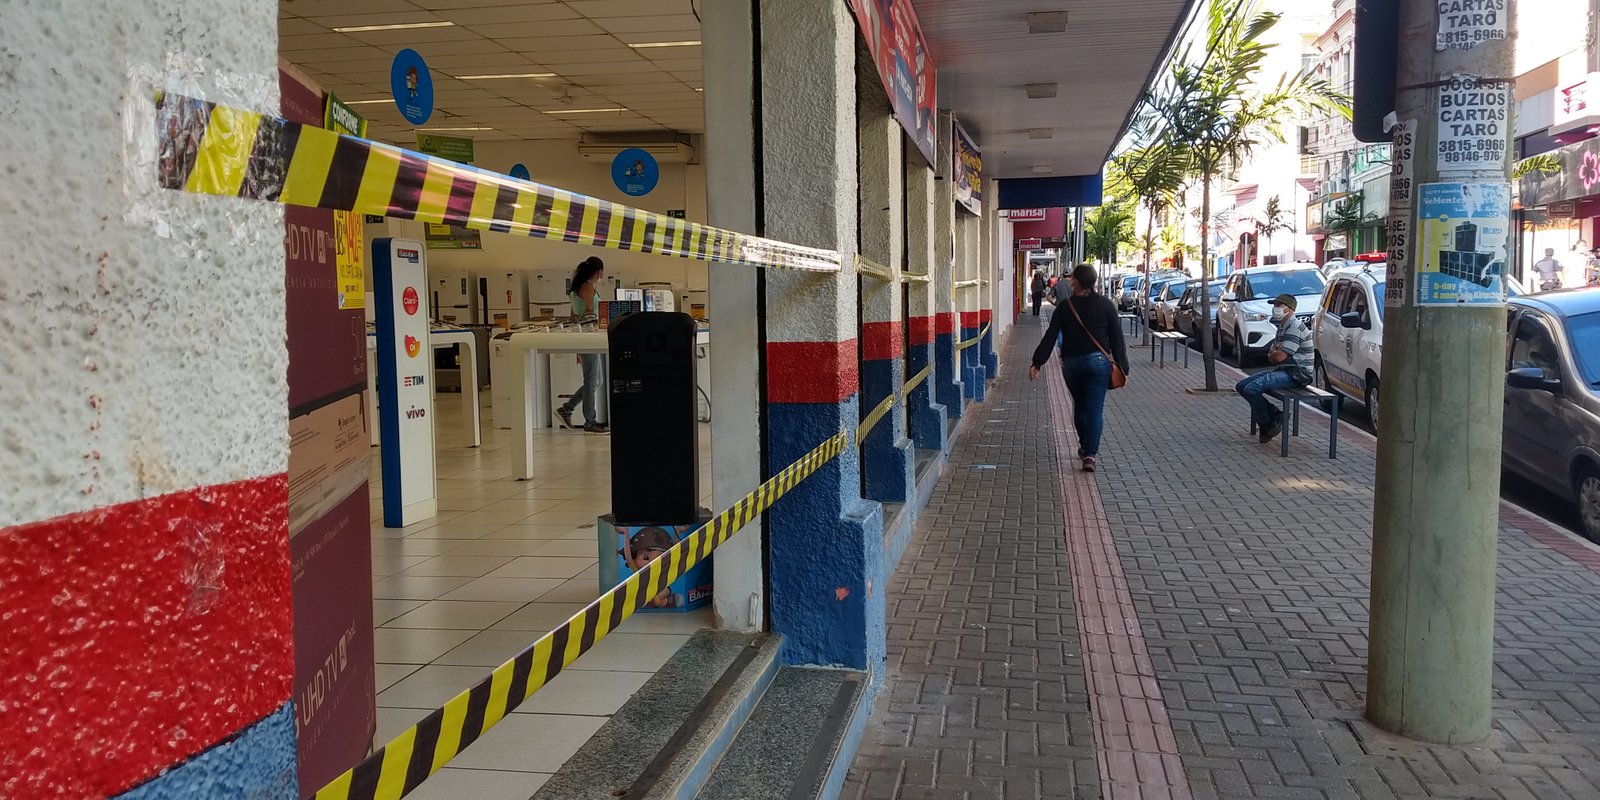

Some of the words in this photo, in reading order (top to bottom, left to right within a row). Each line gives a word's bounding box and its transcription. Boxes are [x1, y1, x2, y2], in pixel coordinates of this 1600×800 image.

[1439, 0, 1504, 15] CARTAS
[1447, 10, 1497, 28] TARÔ
[1441, 91, 1505, 107] BÚZIOS
[1441, 109, 1505, 122] CARTAS
[1450, 120, 1498, 136] TARÔ
[1439, 139, 1505, 152] 3815-6966
[1445, 151, 1503, 162] 98146-976
[1010, 208, 1043, 217] marisa
[301, 226, 315, 262] TV
[412, 375, 424, 385] TIM
[302, 668, 325, 726] UHD
[325, 647, 338, 691] TV
